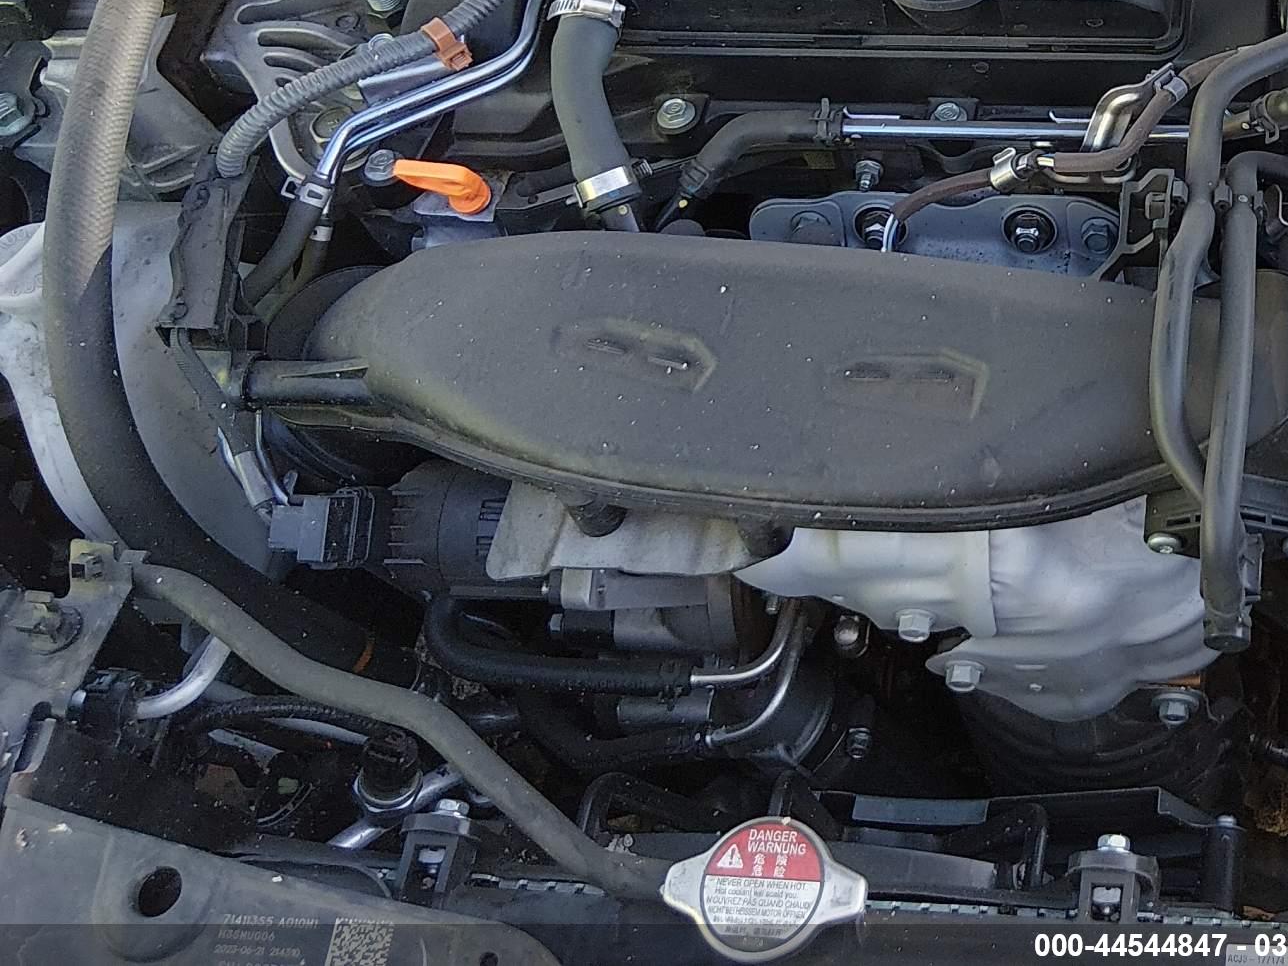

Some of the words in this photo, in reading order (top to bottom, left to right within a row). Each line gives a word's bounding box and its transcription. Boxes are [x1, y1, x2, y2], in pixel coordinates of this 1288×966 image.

[749, 829, 798, 843] DANGER
[747, 840, 806, 855] WARNUNG
[716, 878, 742, 887] NEVER
[744, 879, 765, 888] OPEN
[766, 881, 789, 890] WHEN
[714, 887, 727, 895] Hot
[728, 888, 752, 897] coolant
[754, 889, 765, 897] will
[766, 890, 784, 898] scald
[743, 897, 757, 907] PAS
[758, 898, 784, 908] QUAND
